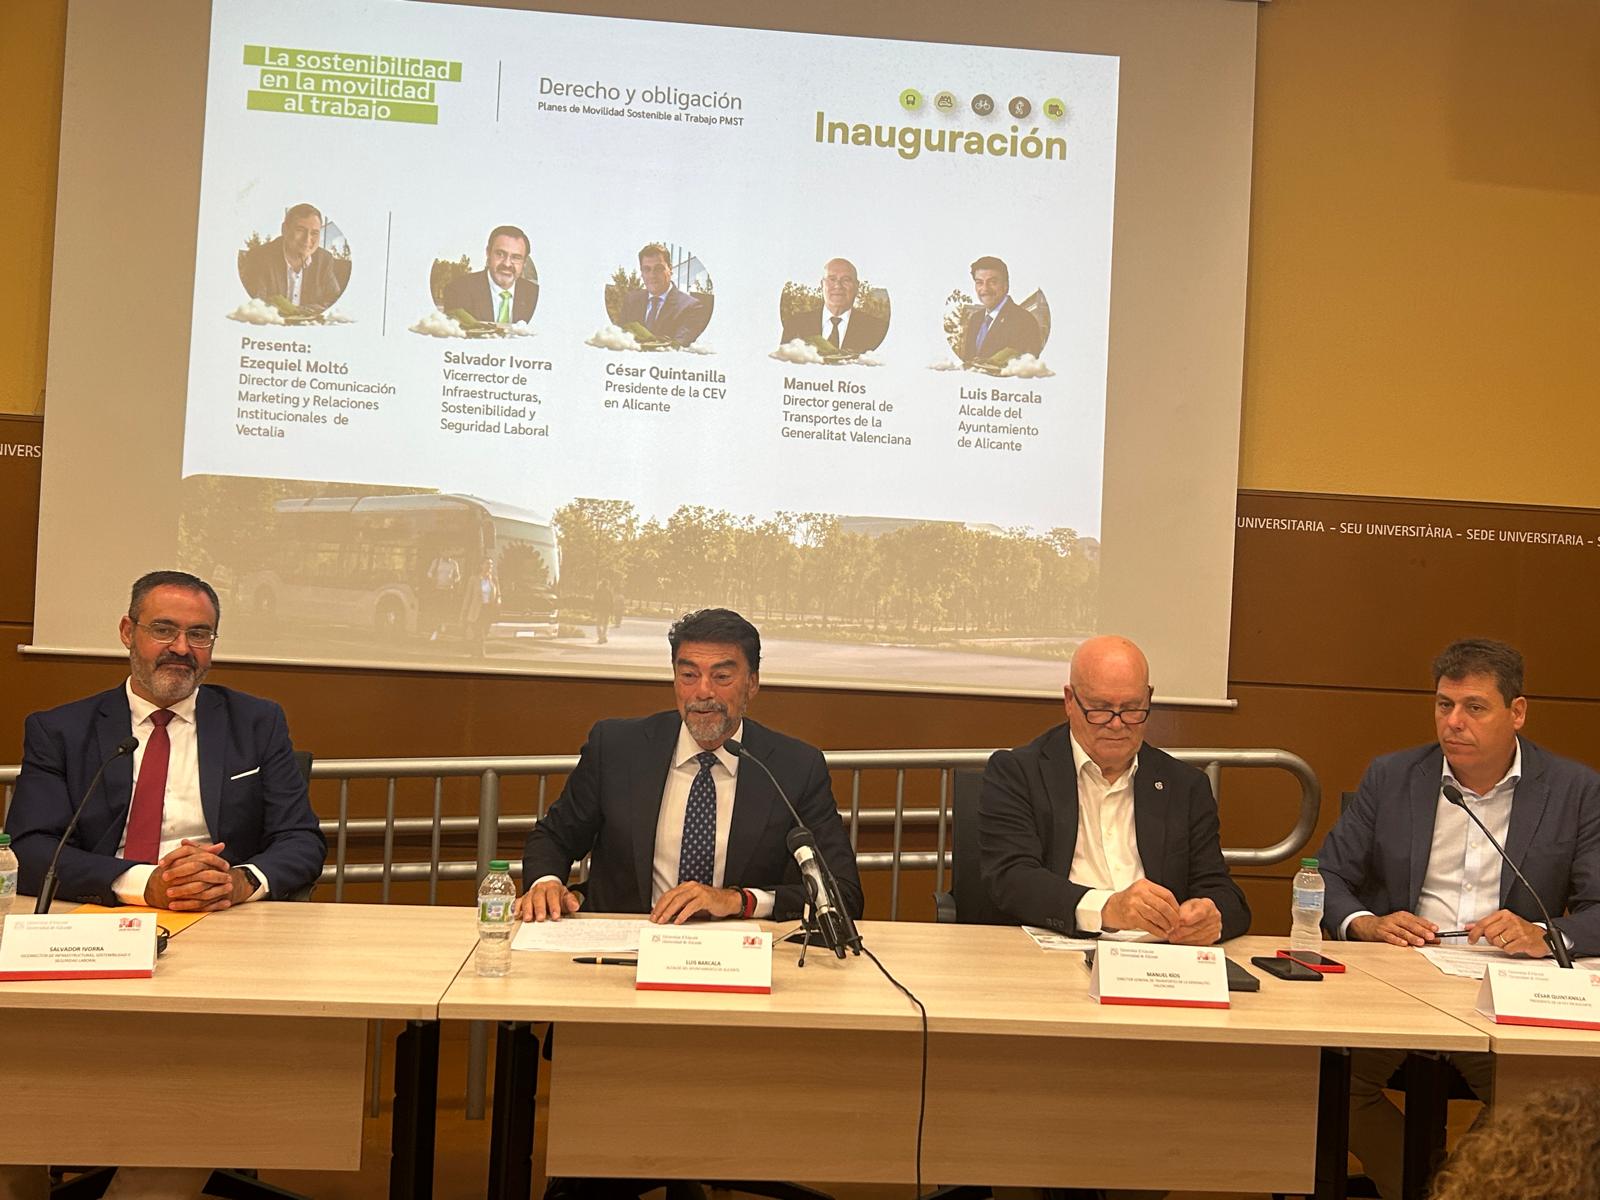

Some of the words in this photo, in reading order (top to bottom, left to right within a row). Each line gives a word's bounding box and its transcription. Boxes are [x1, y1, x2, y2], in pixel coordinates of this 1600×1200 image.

[264, 46, 289, 67] La
[296, 53, 450, 80] sostenibilidad
[262, 73, 289, 88] en
[296, 71, 315, 91] la
[322, 78, 430, 100] movilidad
[539, 77, 620, 100] Derecho
[625, 88, 636, 106] y
[641, 85, 742, 110] obligación
[284, 96, 304, 112] al
[310, 96, 391, 120] trabajo
[538, 102, 567, 113] Planes
[569, 103, 580, 114] de
[582, 105, 625, 117] Movilidad
[627, 109, 672, 121] Sostenible
[674, 113, 682, 122] al
[684, 113, 717, 125] Trabajo
[719, 116, 744, 126] PMST
[815, 111, 1067, 160] Inauguración
[241, 337, 311, 354] Presenta:
[240, 356, 302, 374] Ezequiel
[306, 360, 348, 375] Moltó
[443, 351, 506, 368] Salvador
[510, 356, 552, 371] Ivorra
[443, 368, 509, 384] Vicerrector
[512, 374, 527, 385] de
[606, 363, 646, 377] César
[649, 366, 726, 383] Quintanilla
[239, 373, 288, 387] Director
[291, 377, 306, 389] de
[309, 378, 396, 394] Comunicación
[605, 380, 668, 396] Presidente
[671, 385, 686, 397] de
[688, 386, 699, 398] la
[702, 387, 727, 399] CEV
[783, 377, 834, 392] Manuel
[838, 380, 866, 394] Ríos
[238, 390, 299, 407] Marketing
[302, 396, 310, 408] y
[313, 395, 379, 410] Relaciones
[442, 385, 542, 404] Infraestructuras,
[783, 394, 829, 408] Director
[832, 400, 876, 411] general
[878, 400, 894, 412] de
[960, 386, 987, 400] Luis
[991, 389, 1042, 404] Barcala
[441, 401, 526, 418] Sostenibilidad
[528, 410, 536, 421] y
[604, 399, 619, 408] en
[622, 398, 671, 412] Alicante
[958, 404, 1001, 418] Alcalde
[1003, 407, 1022, 419] del
[237, 407, 327, 424] Institucionales
[333, 413, 349, 425] de
[783, 410, 851, 426] Transportes
[854, 415, 868, 427] de
[871, 416, 882, 428] la
[236, 424, 285, 438] Vectalia
[440, 418, 500, 434] Seguridad
[504, 422, 549, 437] Laboral
[781, 427, 847, 442] Generalitat
[850, 431, 912, 446] Valenciana
[958, 421, 1039, 436] Ayuntamiento
[957, 436, 971, 448] de
[974, 438, 1023, 451] Alicante
[1237, 516, 1325, 533] UNIVERSITARIA
[1340, 522, 1362, 534] SEU
[1366, 523, 1453, 539] UNIVERSITÀRIA
[1466, 528, 1495, 541] SEDE
[1499, 530, 1584, 546] UNIVERSITARIA
